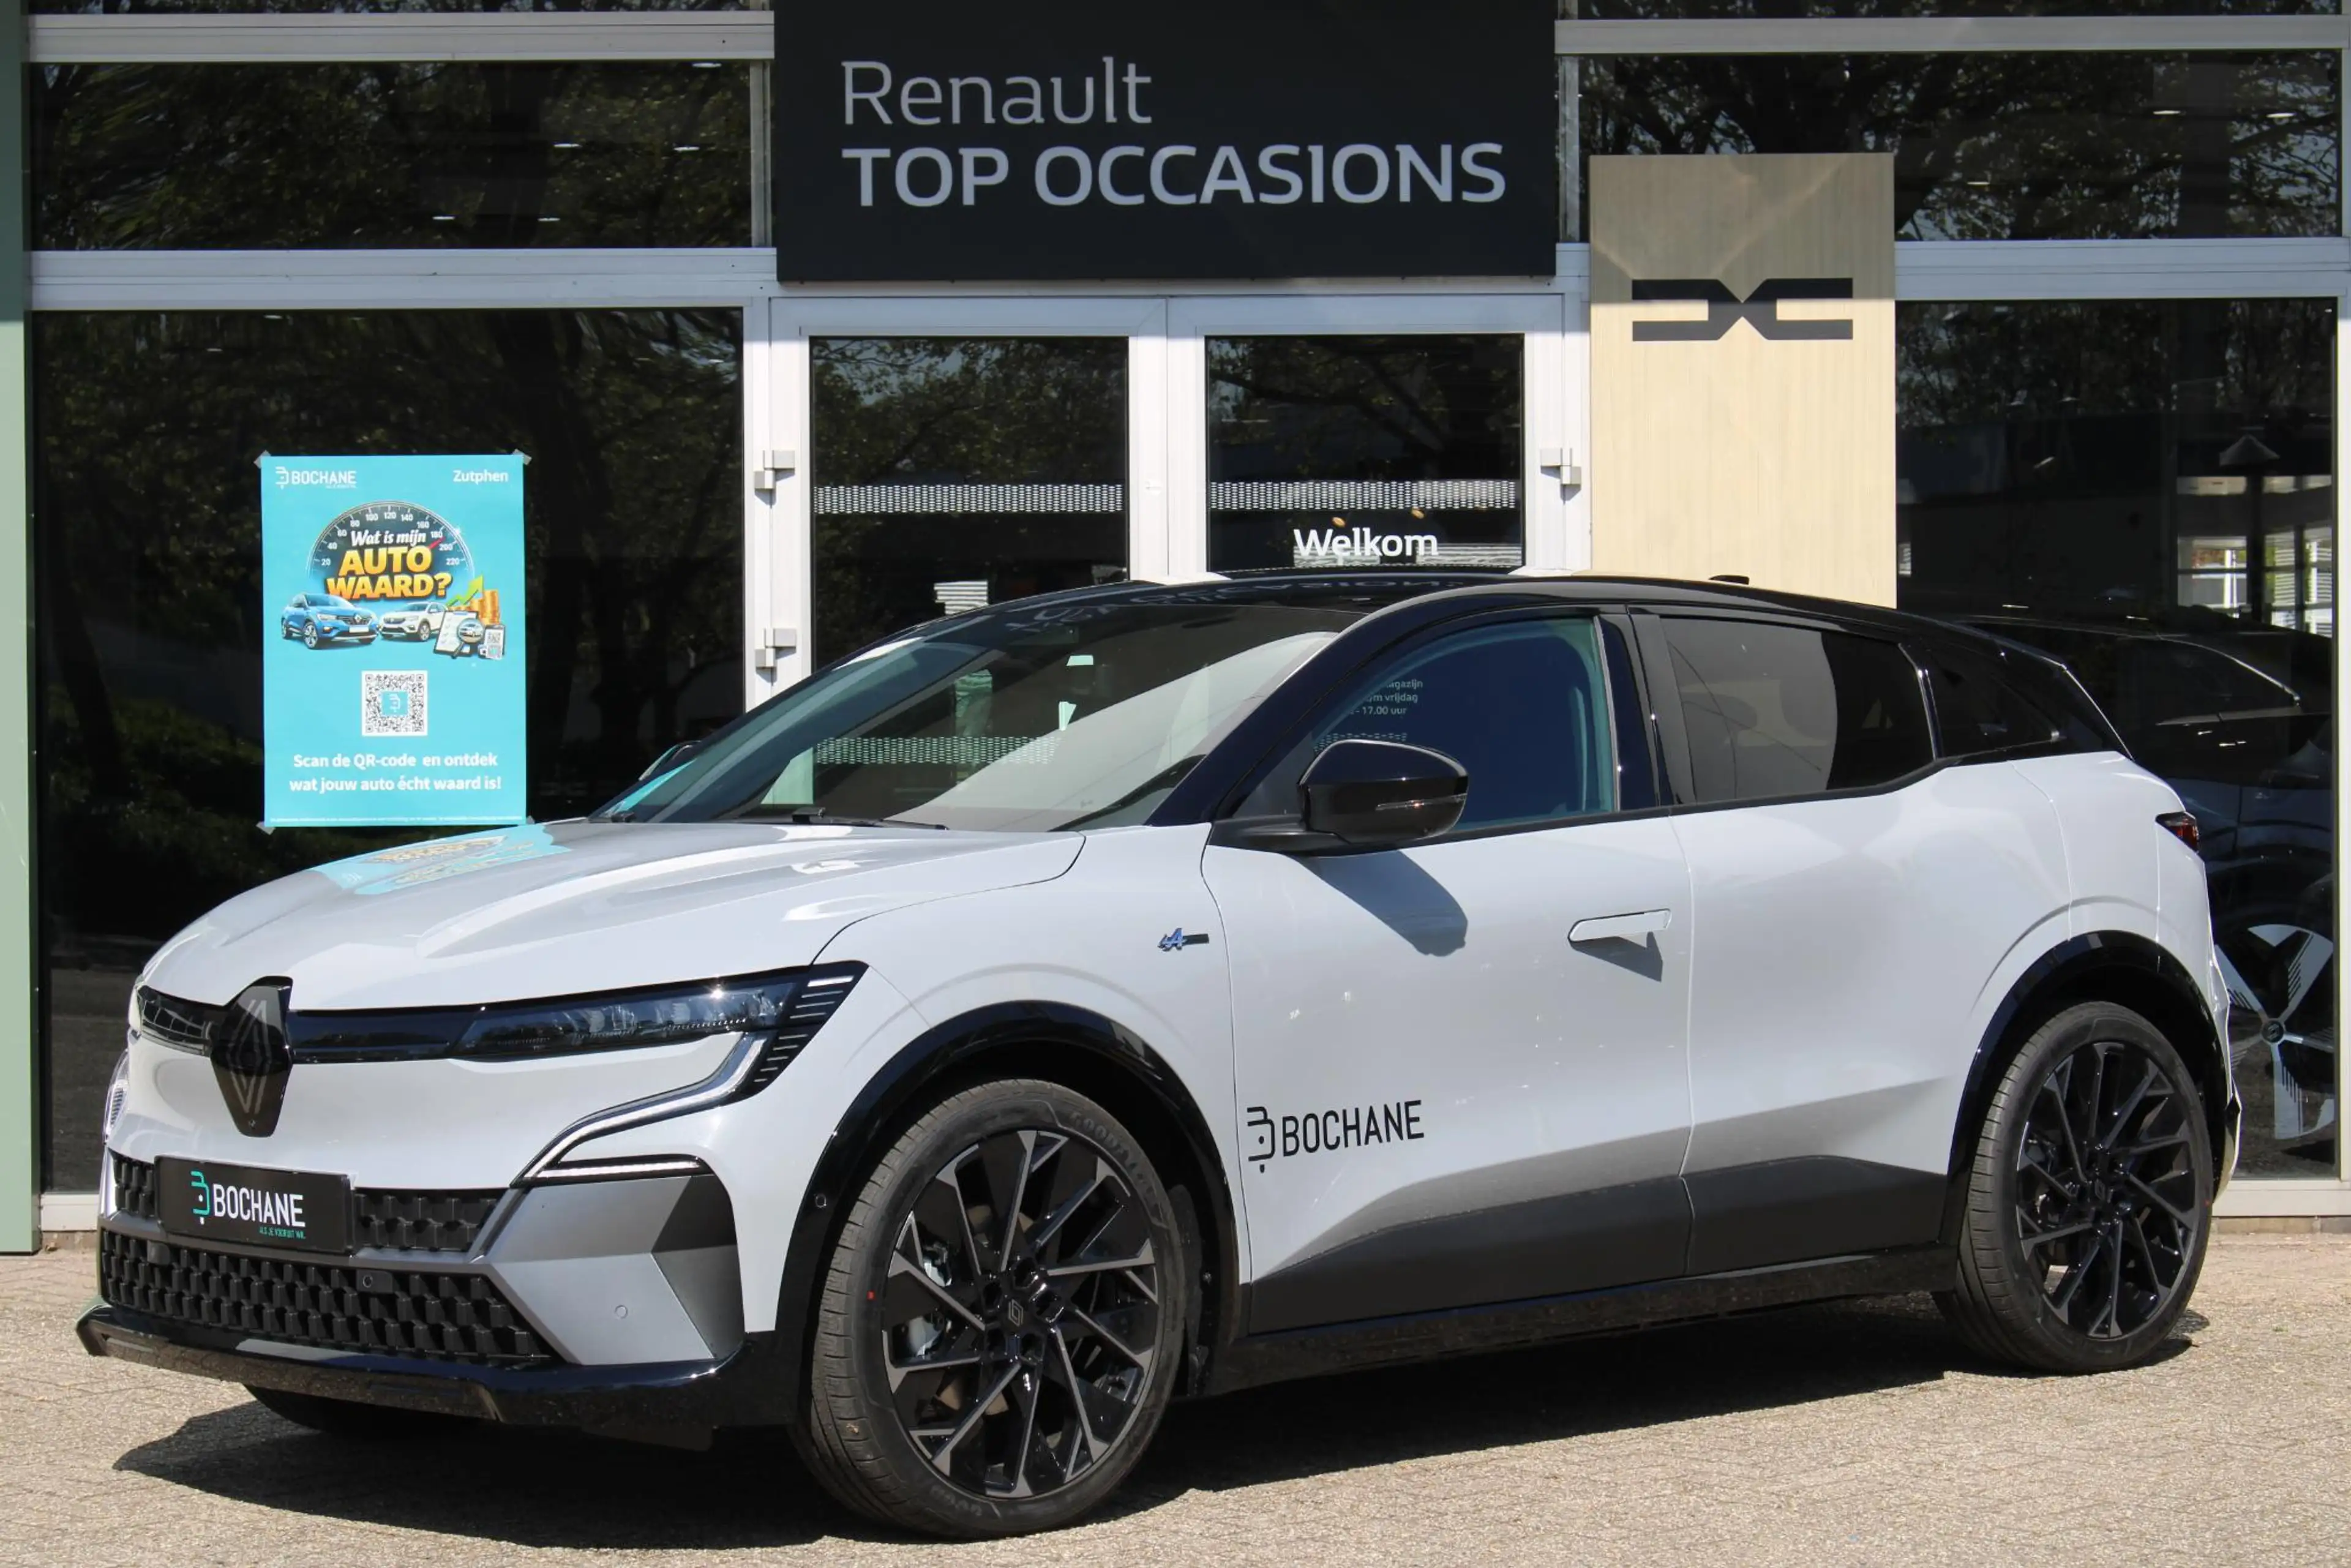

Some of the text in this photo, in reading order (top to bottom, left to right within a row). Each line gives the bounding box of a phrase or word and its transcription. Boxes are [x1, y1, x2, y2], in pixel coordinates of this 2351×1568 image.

[842, 56, 1152, 126] Renault
[842, 142, 1506, 207] TOP OCCASIONS
[291, 470, 358, 485] BOCHANE
[453, 470, 509, 486] Zutphen
[350, 529, 427, 547] Wat is mijn
[1293, 527, 1438, 557] Welkom
[338, 546, 432, 576] AUTO
[326, 572, 452, 599] WAARD?
[1387, 679, 1423, 690] agazijn
[1385, 692, 1419, 703] vrijdag
[1362, 706, 1389, 715] 17.00
[293, 752, 498, 770] Scan de QR-code en ontdek
[289, 775, 501, 794] wat jouw auto écht waard is!
[1282, 1100, 1424, 1157] BOCHANE
[212, 1182, 306, 1228] BOCHANE
